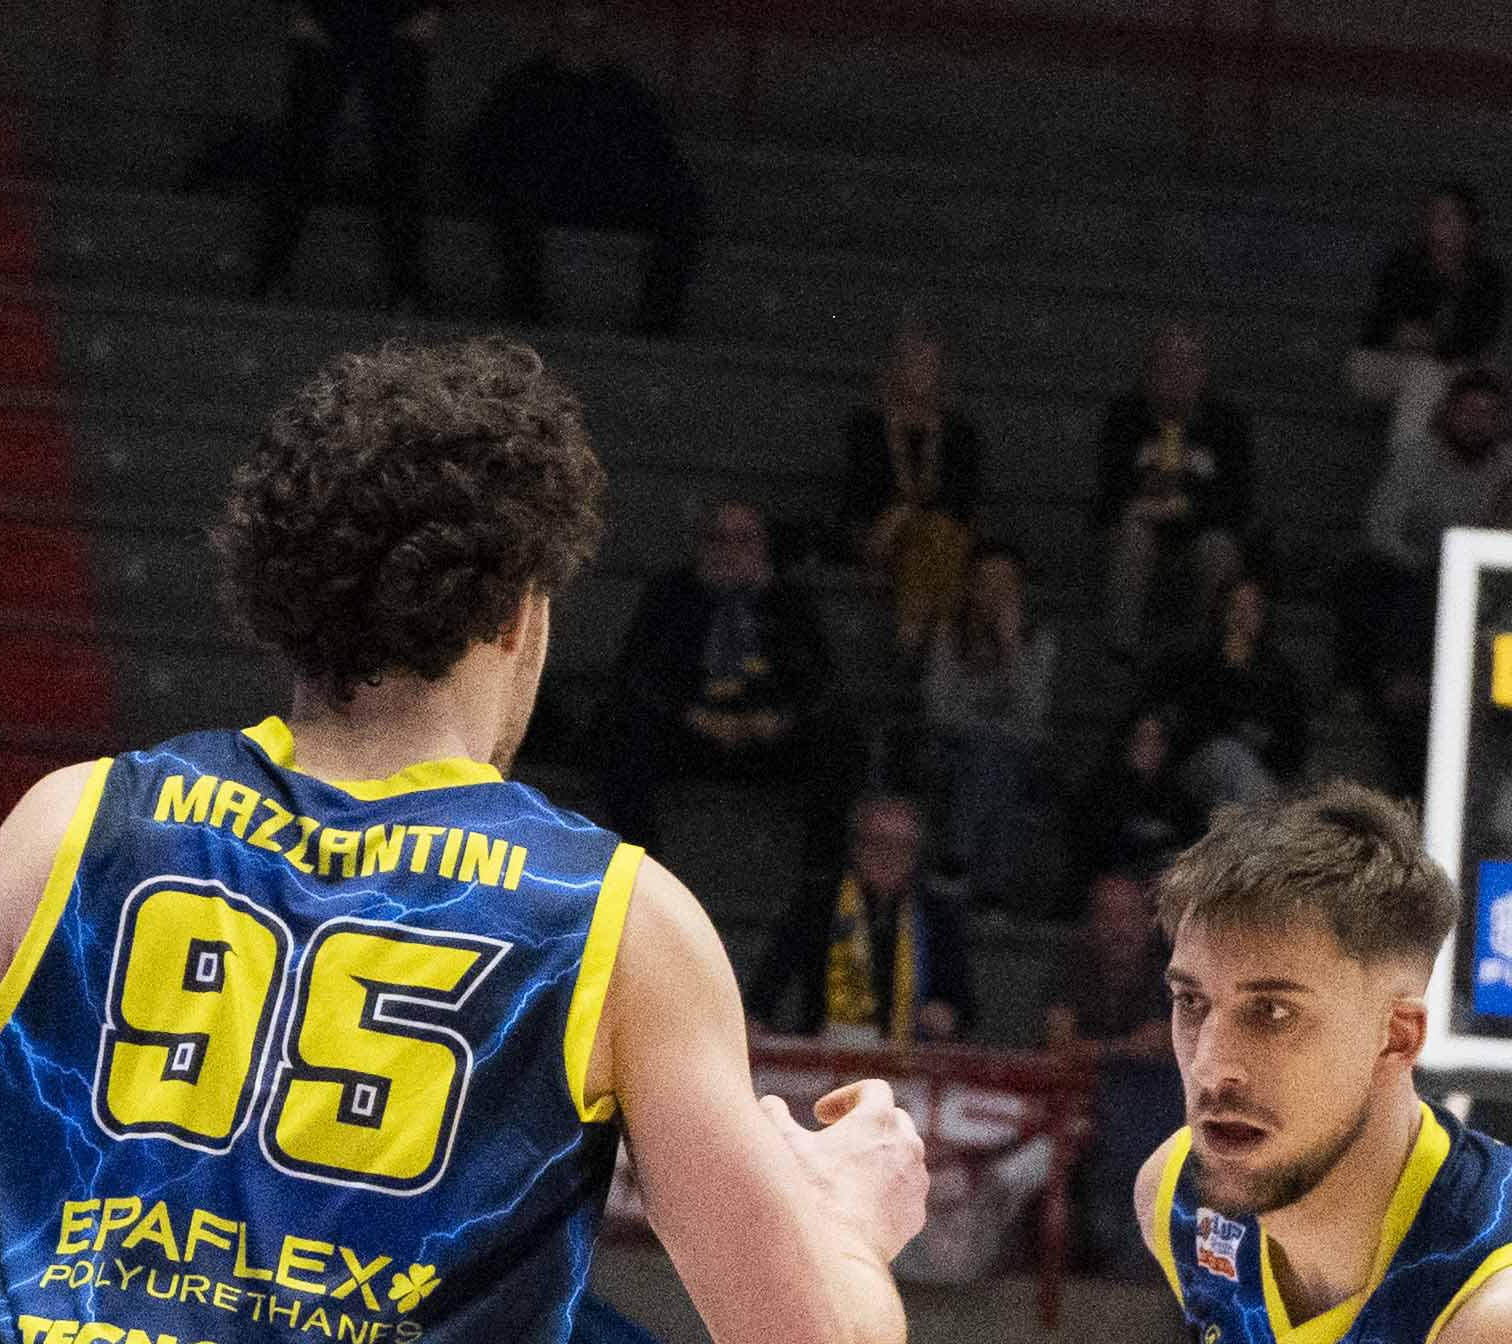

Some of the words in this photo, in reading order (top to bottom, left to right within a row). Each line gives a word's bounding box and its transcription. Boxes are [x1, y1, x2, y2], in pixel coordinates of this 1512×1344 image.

[153, 774, 527, 890] MAZZANTINI
[91, 875, 511, 1195] 95
[56, 1196, 392, 1311] EPAFLEX
